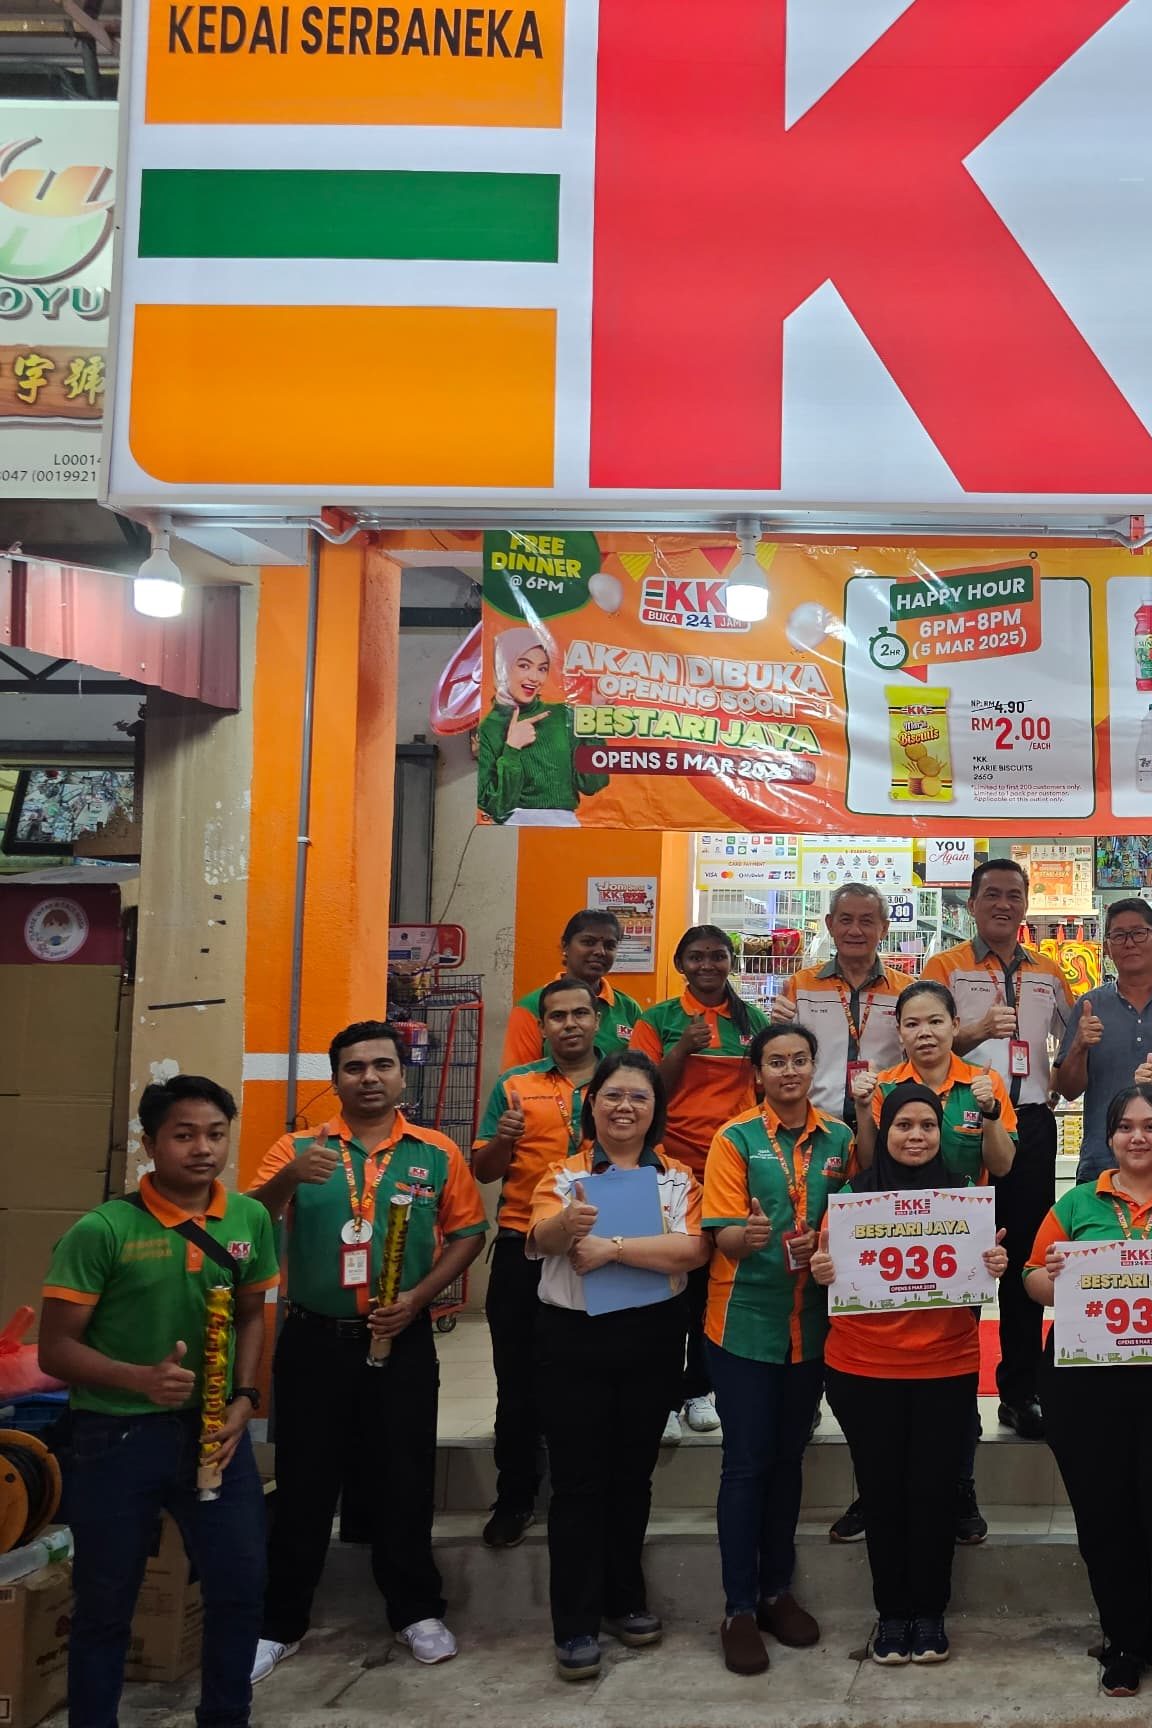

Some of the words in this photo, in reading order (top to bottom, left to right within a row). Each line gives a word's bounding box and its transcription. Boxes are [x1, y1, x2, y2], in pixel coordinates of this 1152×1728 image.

[168, 5, 290, 54] KEDAI
[301, 5, 544, 59] SERBANEKA
[510, 534, 566, 556] FREE
[491, 551, 582, 579] DINNER
[525, 576, 564, 594] 6PM
[665, 580, 728, 614] KK
[896, 585, 964, 611] HAPPY
[967, 577, 1026, 601] HOUR
[648, 610, 678, 624] BUKA
[685, 614, 712, 628] 24
[919, 608, 1022, 638] 6PM-8PM
[912, 641, 931, 660] (5
[935, 638, 975, 656] MAR
[979, 626, 1028, 650] 2025)
[564, 641, 680, 685] AKAN
[686, 655, 830, 699] DIBUKA
[600, 675, 718, 711] OPENING
[721, 690, 794, 717] SOON
[575, 705, 719, 745] BESTARI
[719, 719, 822, 755] JAYA
[971, 716, 1051, 751] RM2.00
[591, 751, 662, 770] OPENS
[666, 752, 678, 770] 5
[683, 753, 736, 776] MAR
[929, 850, 970, 864] Again
[935, 841, 966, 851] YOU
[901, 1198, 925, 1211] KK
[855, 1222, 923, 1240] BESTARI
[923, 1219, 970, 1236] JAYA
[858, 1244, 958, 1282] #936
[1127, 1249, 1150, 1261] KK
[1080, 1274, 1150, 1290] BESTARI
